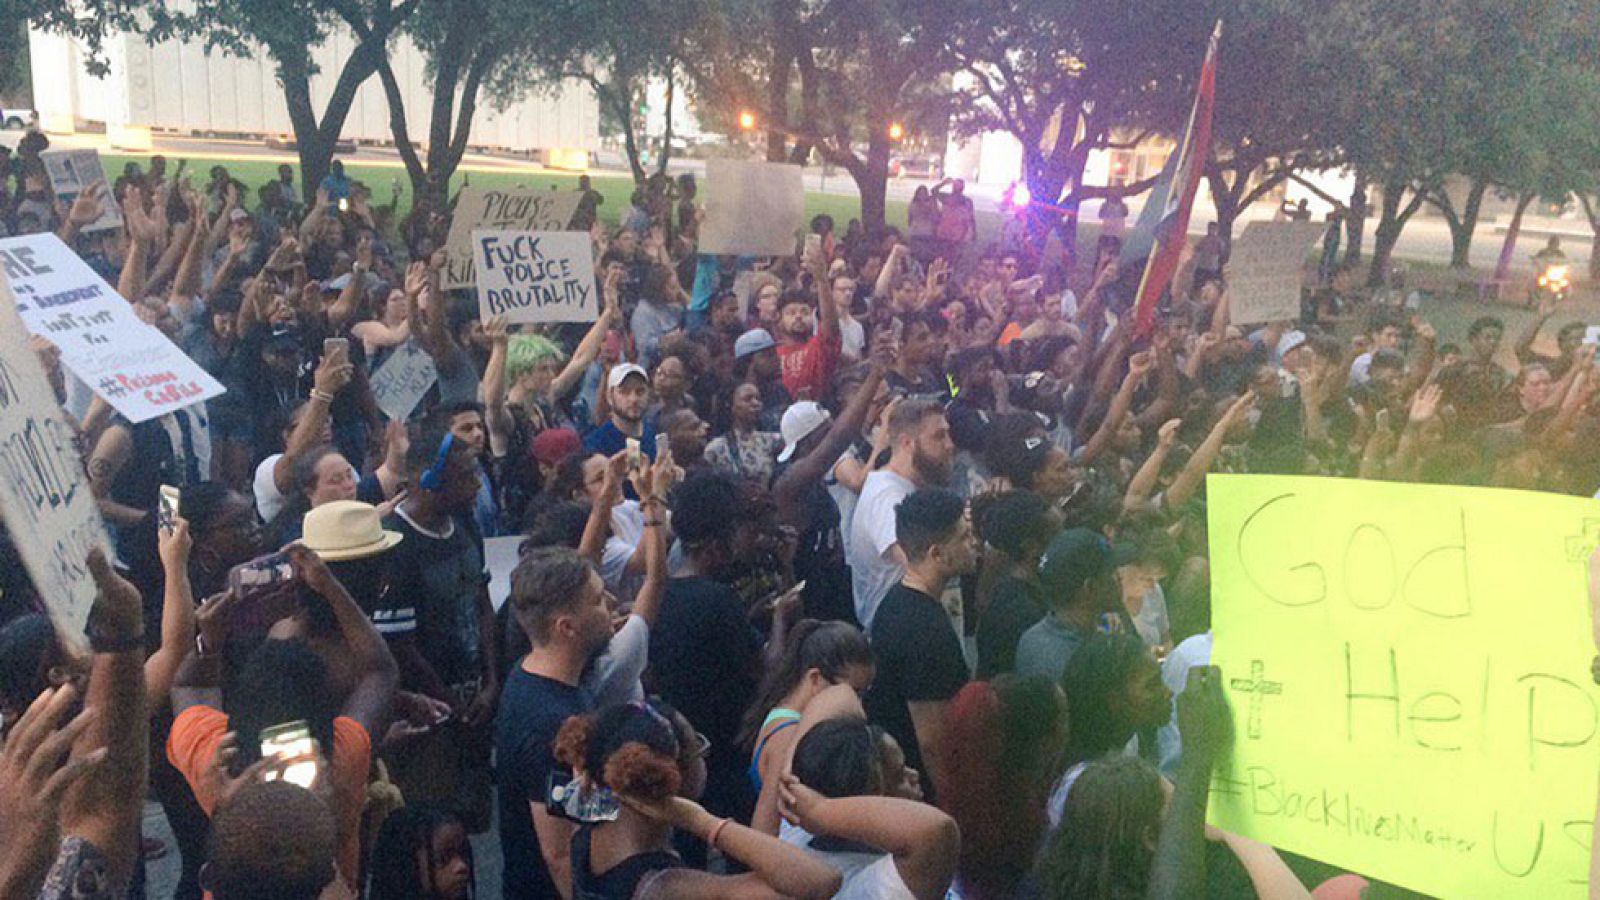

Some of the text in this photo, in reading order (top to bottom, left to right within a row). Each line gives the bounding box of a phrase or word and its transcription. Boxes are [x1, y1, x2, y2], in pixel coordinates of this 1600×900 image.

[481, 235, 545, 270] FUCK
[503, 259, 572, 285] POLICE
[487, 279, 590, 315] BRUTALITY
[1238, 493, 1473, 619] God
[1346, 642, 1598, 772] Help
